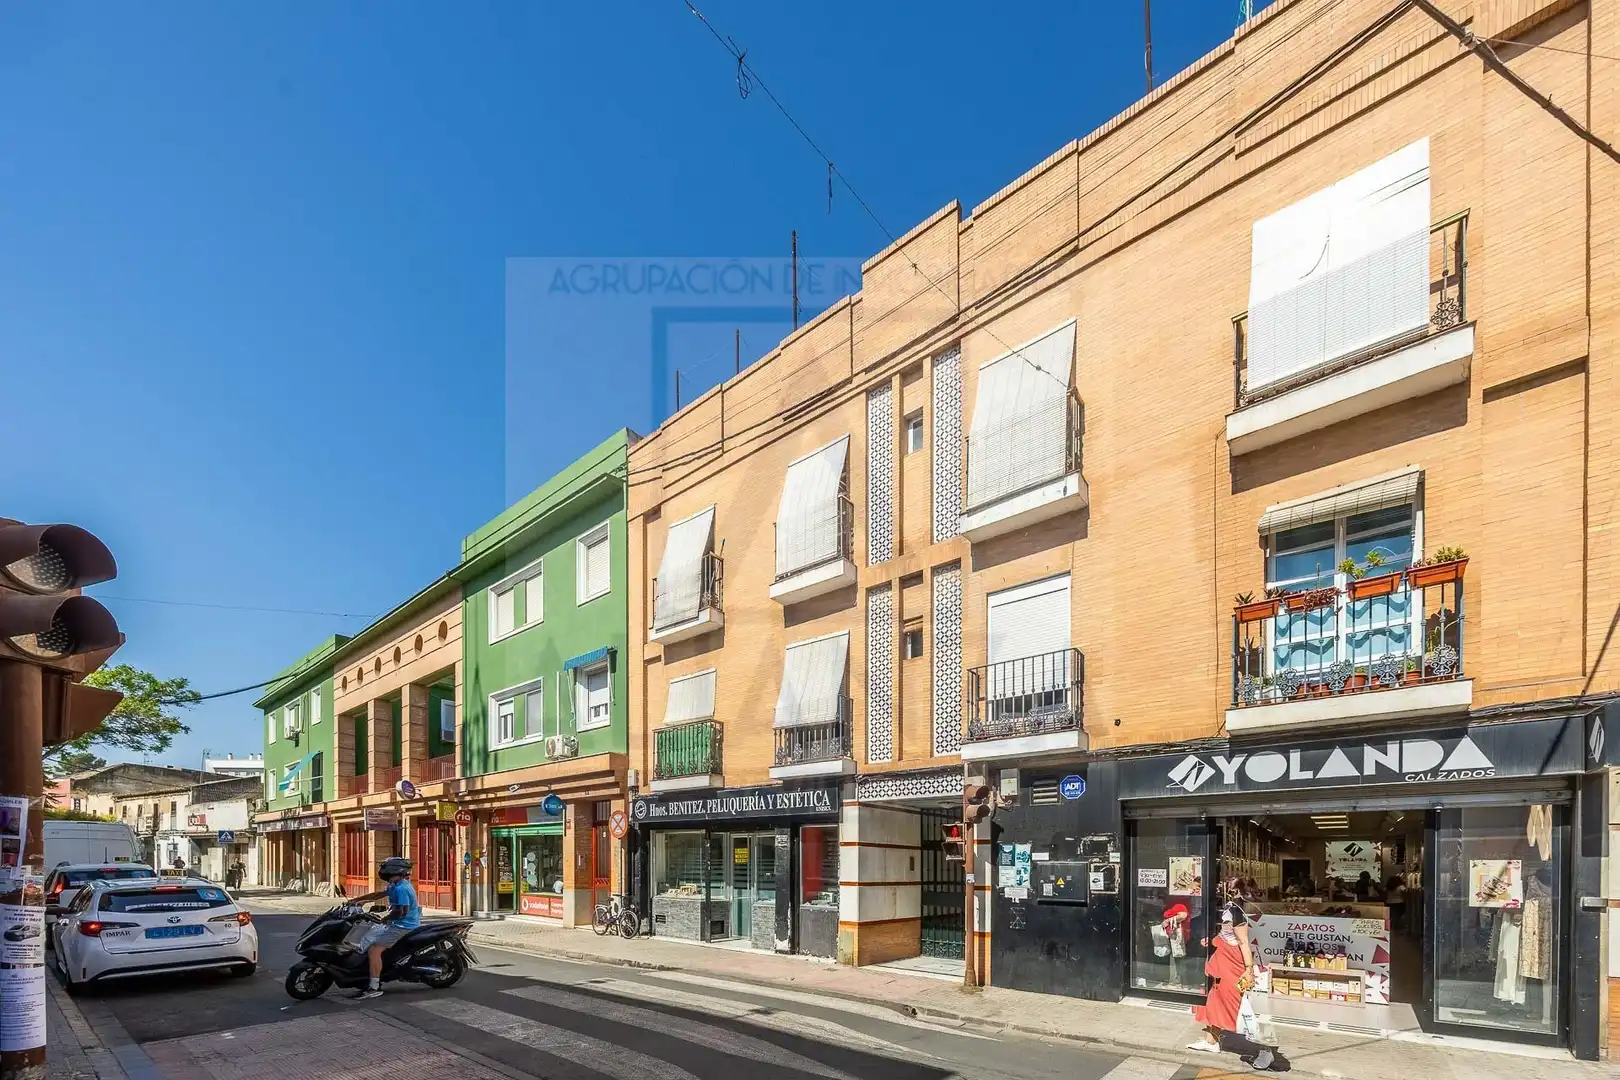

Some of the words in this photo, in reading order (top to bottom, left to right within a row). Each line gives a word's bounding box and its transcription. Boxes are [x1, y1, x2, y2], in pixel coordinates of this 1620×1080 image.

[1211, 734, 1495, 784] YOLANDA
[1405, 769, 1496, 782] CALZADOS
[1066, 782, 1081, 790] ADT
[707, 791, 766, 814] PELUQUERÍA
[768, 794, 775, 808] Y
[776, 788, 830, 806] ESTÉTICA
[456, 812, 471, 821] ria
[1287, 922, 1336, 933] ZAPATOS
[105, 930, 131, 938] IMPAR
[1269, 930, 1292, 940] QUE
[1294, 932, 1305, 940] TE
[1307, 933, 1354, 944] GUSTAN,
